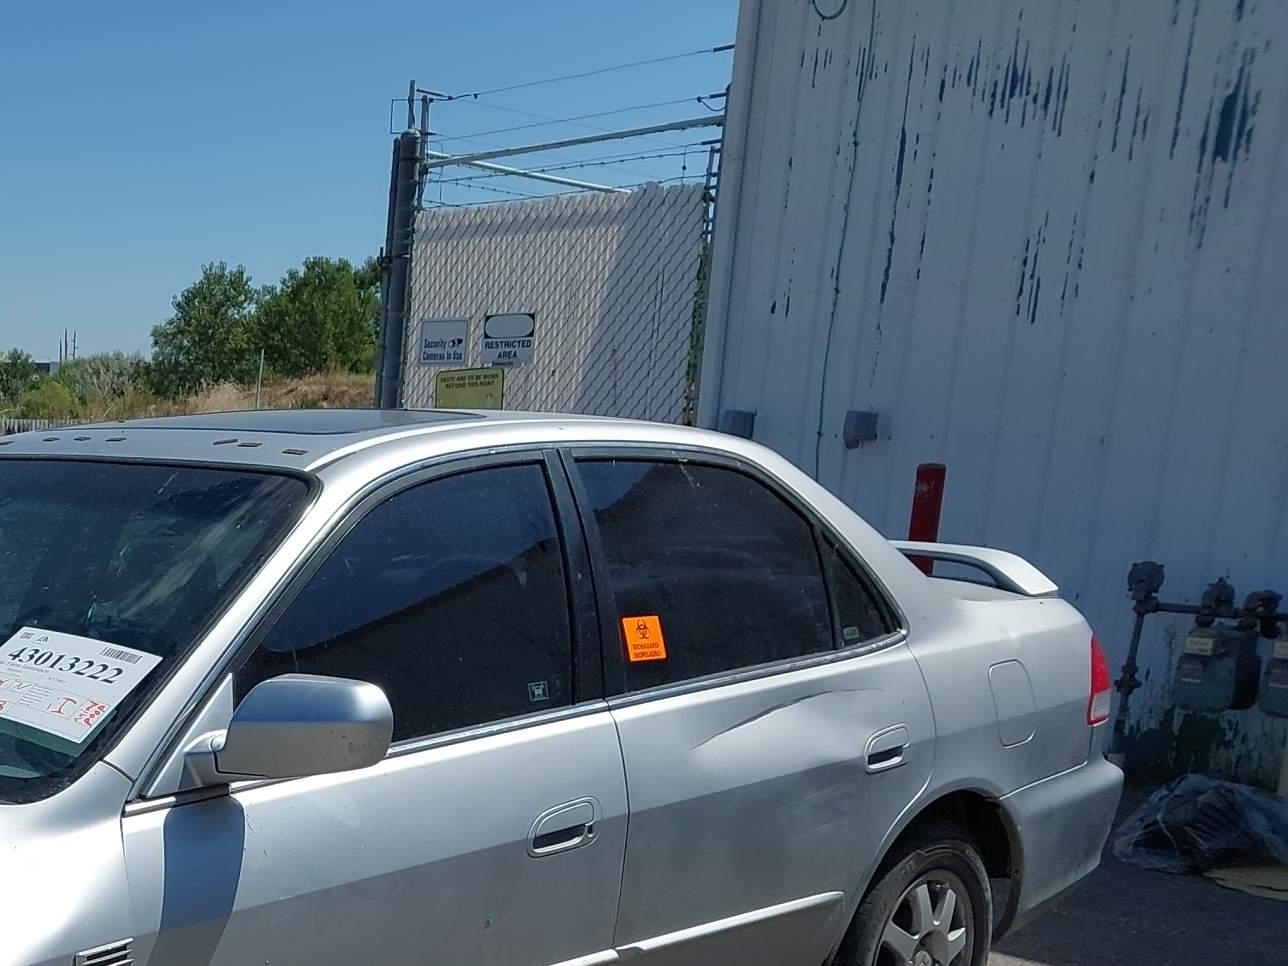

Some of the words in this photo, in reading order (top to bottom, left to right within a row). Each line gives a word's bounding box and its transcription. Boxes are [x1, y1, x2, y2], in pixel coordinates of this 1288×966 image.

[424, 338, 447, 349] Security
[485, 340, 532, 350] RESTRICTED
[423, 351, 445, 361] Cameras
[497, 351, 518, 360] AREA
[8, 646, 124, 684] 43013222
